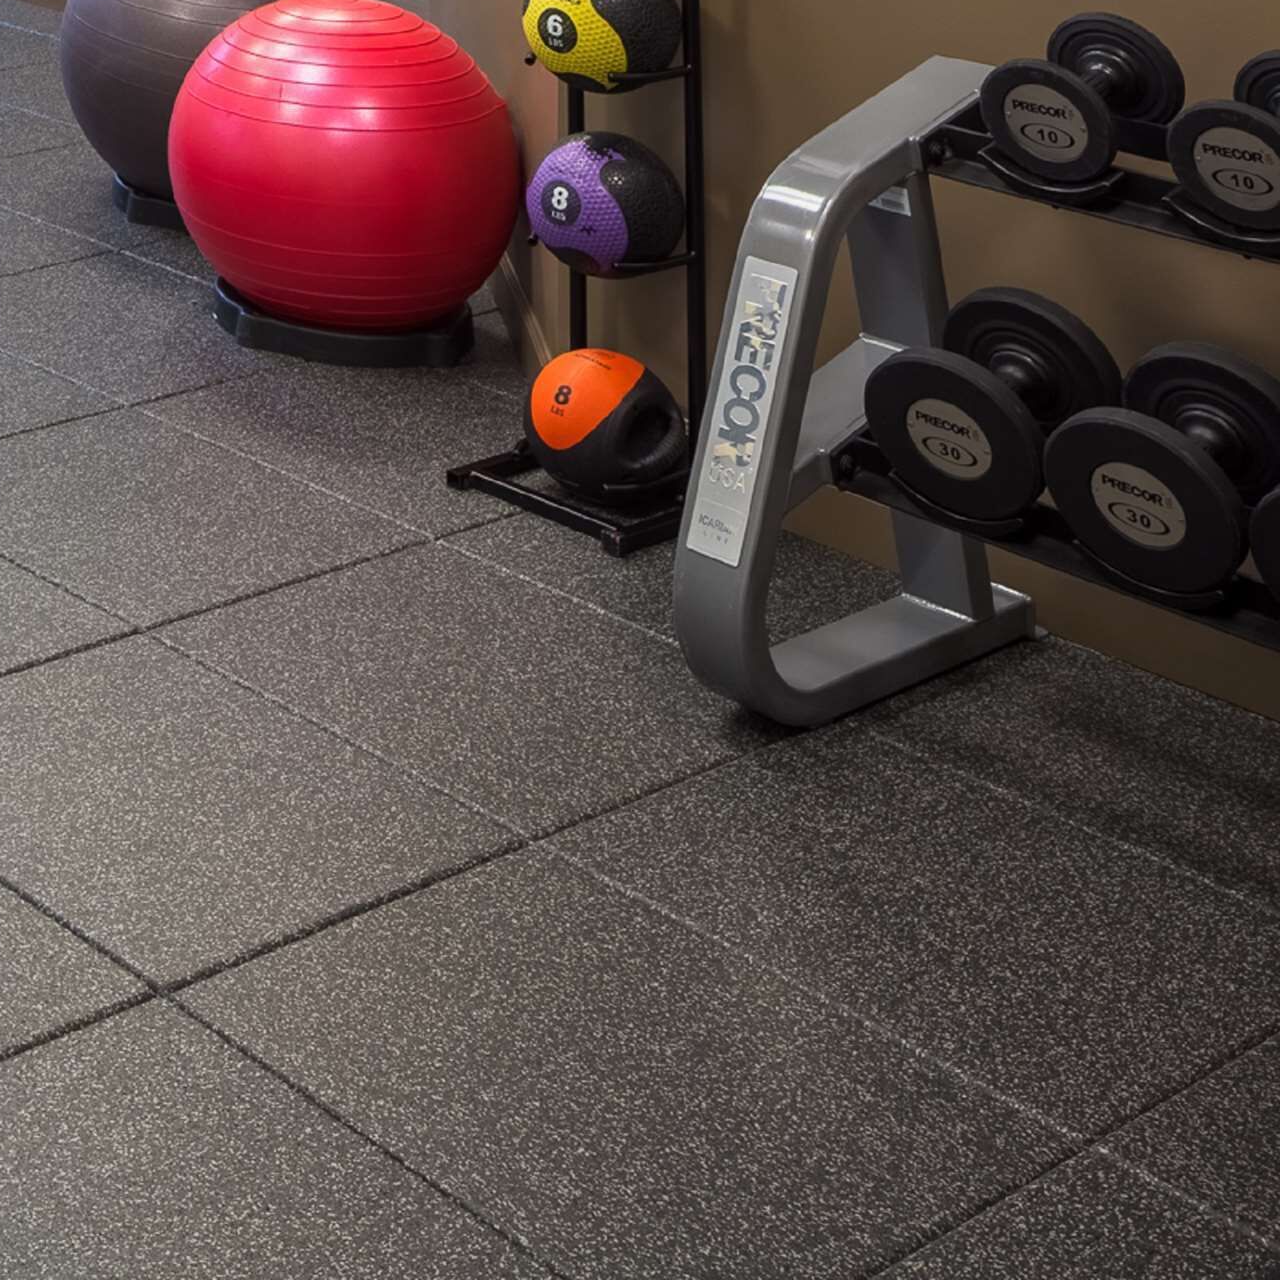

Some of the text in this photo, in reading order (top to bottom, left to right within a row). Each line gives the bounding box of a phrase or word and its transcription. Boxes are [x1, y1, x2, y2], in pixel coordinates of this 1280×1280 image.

[546, 14, 563, 37] 6
[1012, 99, 1068, 120] PRECOR
[1037, 128, 1058, 145] 10
[1202, 142, 1265, 164] PRECOR
[1231, 173, 1255, 190] 10
[551, 186, 569, 210] 8
[554, 385, 572, 405] 8
[915, 410, 972, 440] PRECOR
[939, 442, 961, 461] 30
[707, 462, 748, 495] USA
[1101, 473, 1165, 507] PRECOR
[1127, 508, 1151, 529] 30
